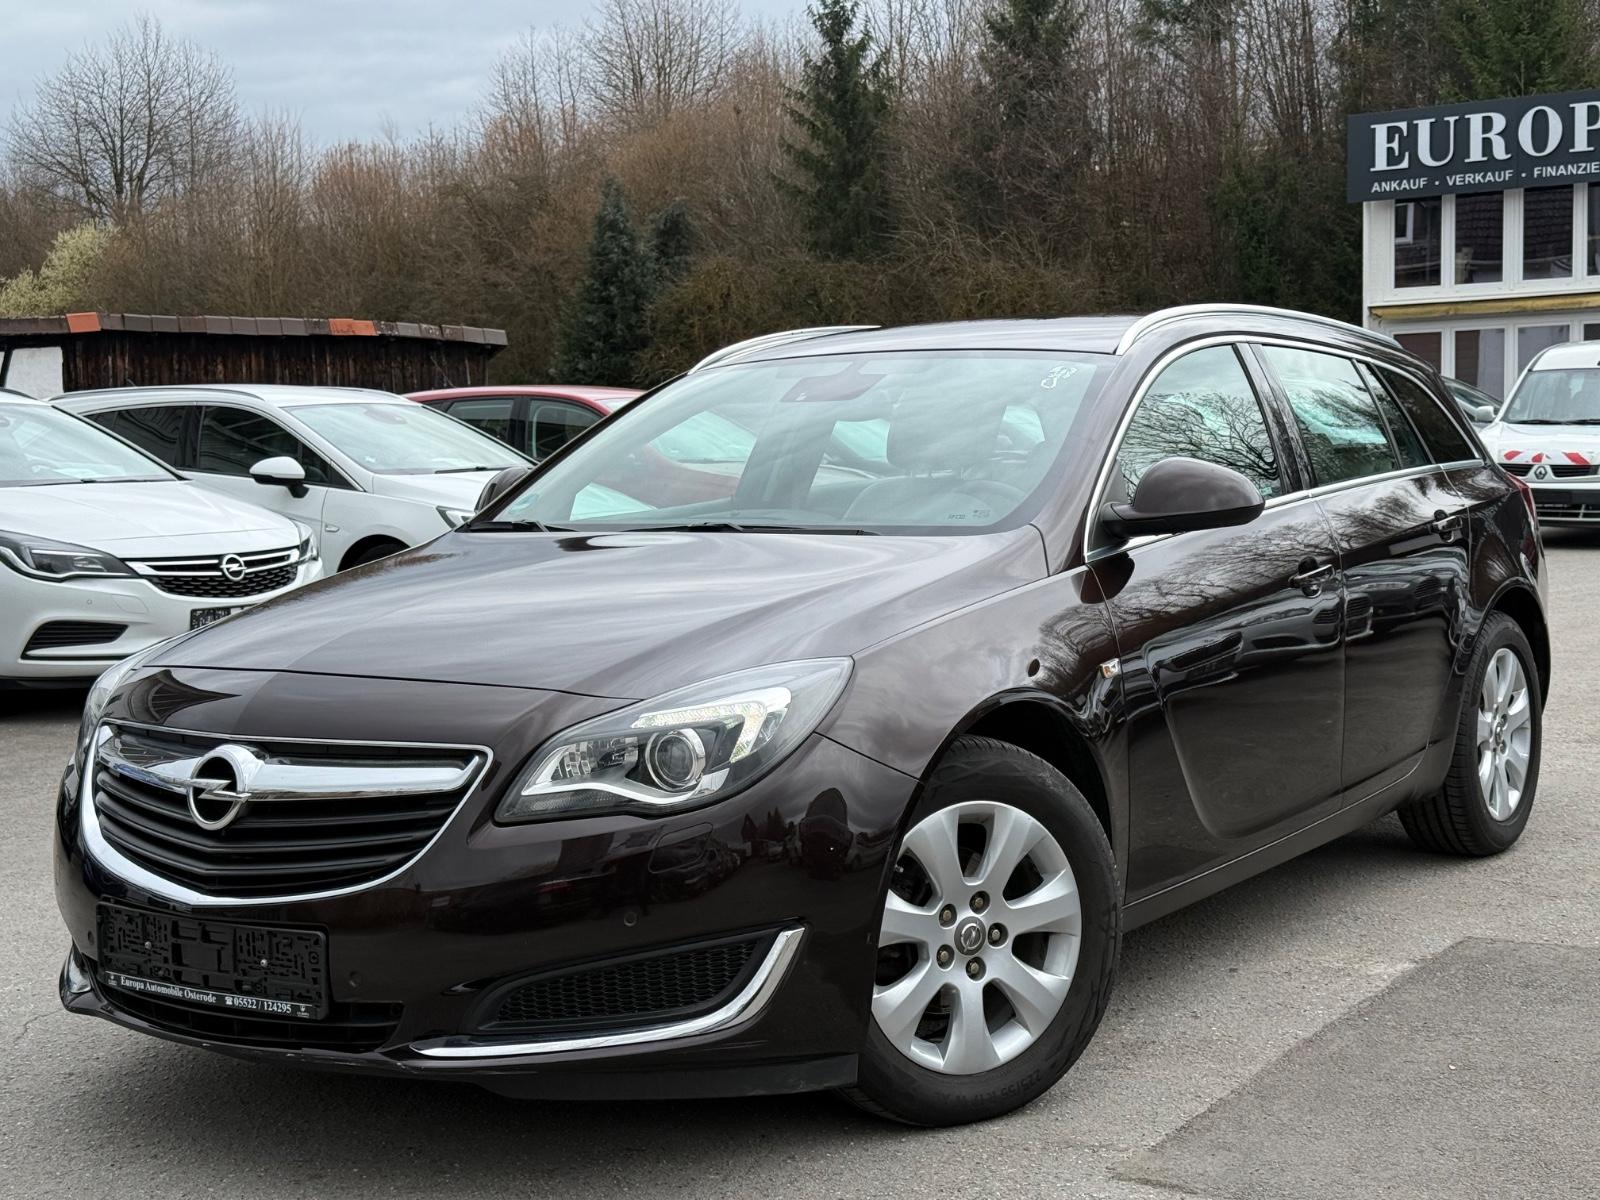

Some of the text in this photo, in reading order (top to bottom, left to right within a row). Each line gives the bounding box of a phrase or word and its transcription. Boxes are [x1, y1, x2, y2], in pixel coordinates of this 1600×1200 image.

[1370, 101, 1600, 172] EUROP
[1371, 162, 1600, 193] ANKAUF VERKAUF FINANZIE
[121, 976, 145, 991] Europa
[145, 982, 183, 998] Automobile
[184, 989, 217, 1004] Osterode
[233, 997, 257, 1009] 05522
[264, 1001, 292, 1014] 124295
